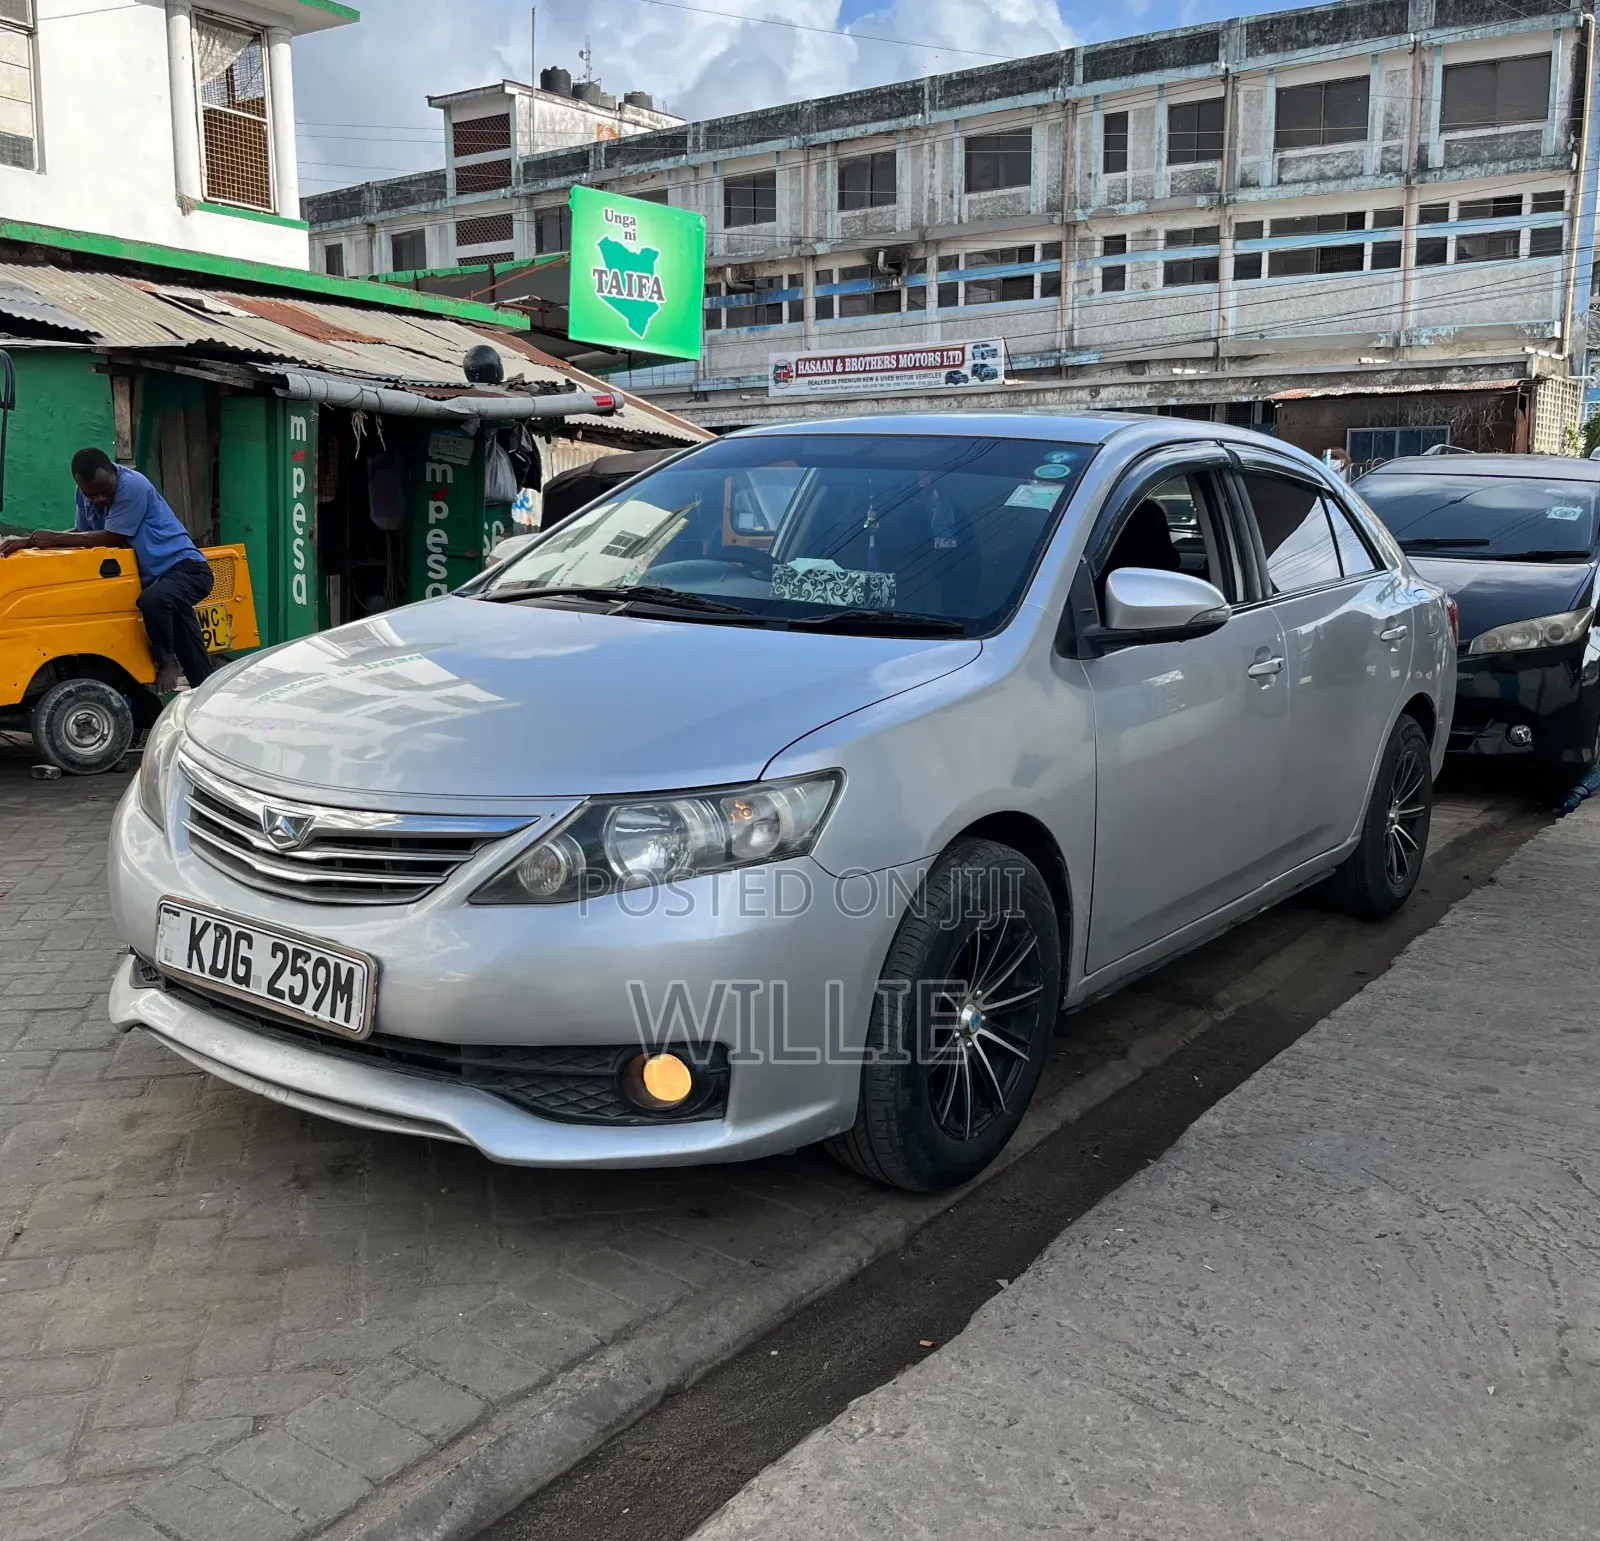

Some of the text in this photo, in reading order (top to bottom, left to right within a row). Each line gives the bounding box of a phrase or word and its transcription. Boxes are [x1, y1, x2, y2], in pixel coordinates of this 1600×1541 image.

[604, 208, 637, 227] Unga
[624, 229, 637, 241] ni
[592, 268, 666, 302] TAIFA
[798, 351, 962, 374] HASAAN & BROTHERS MOTORS LTD
[915, 372, 942, 380] VEHICLES
[187, 916, 253, 988] KDG
[266, 940, 354, 1024] 259M
